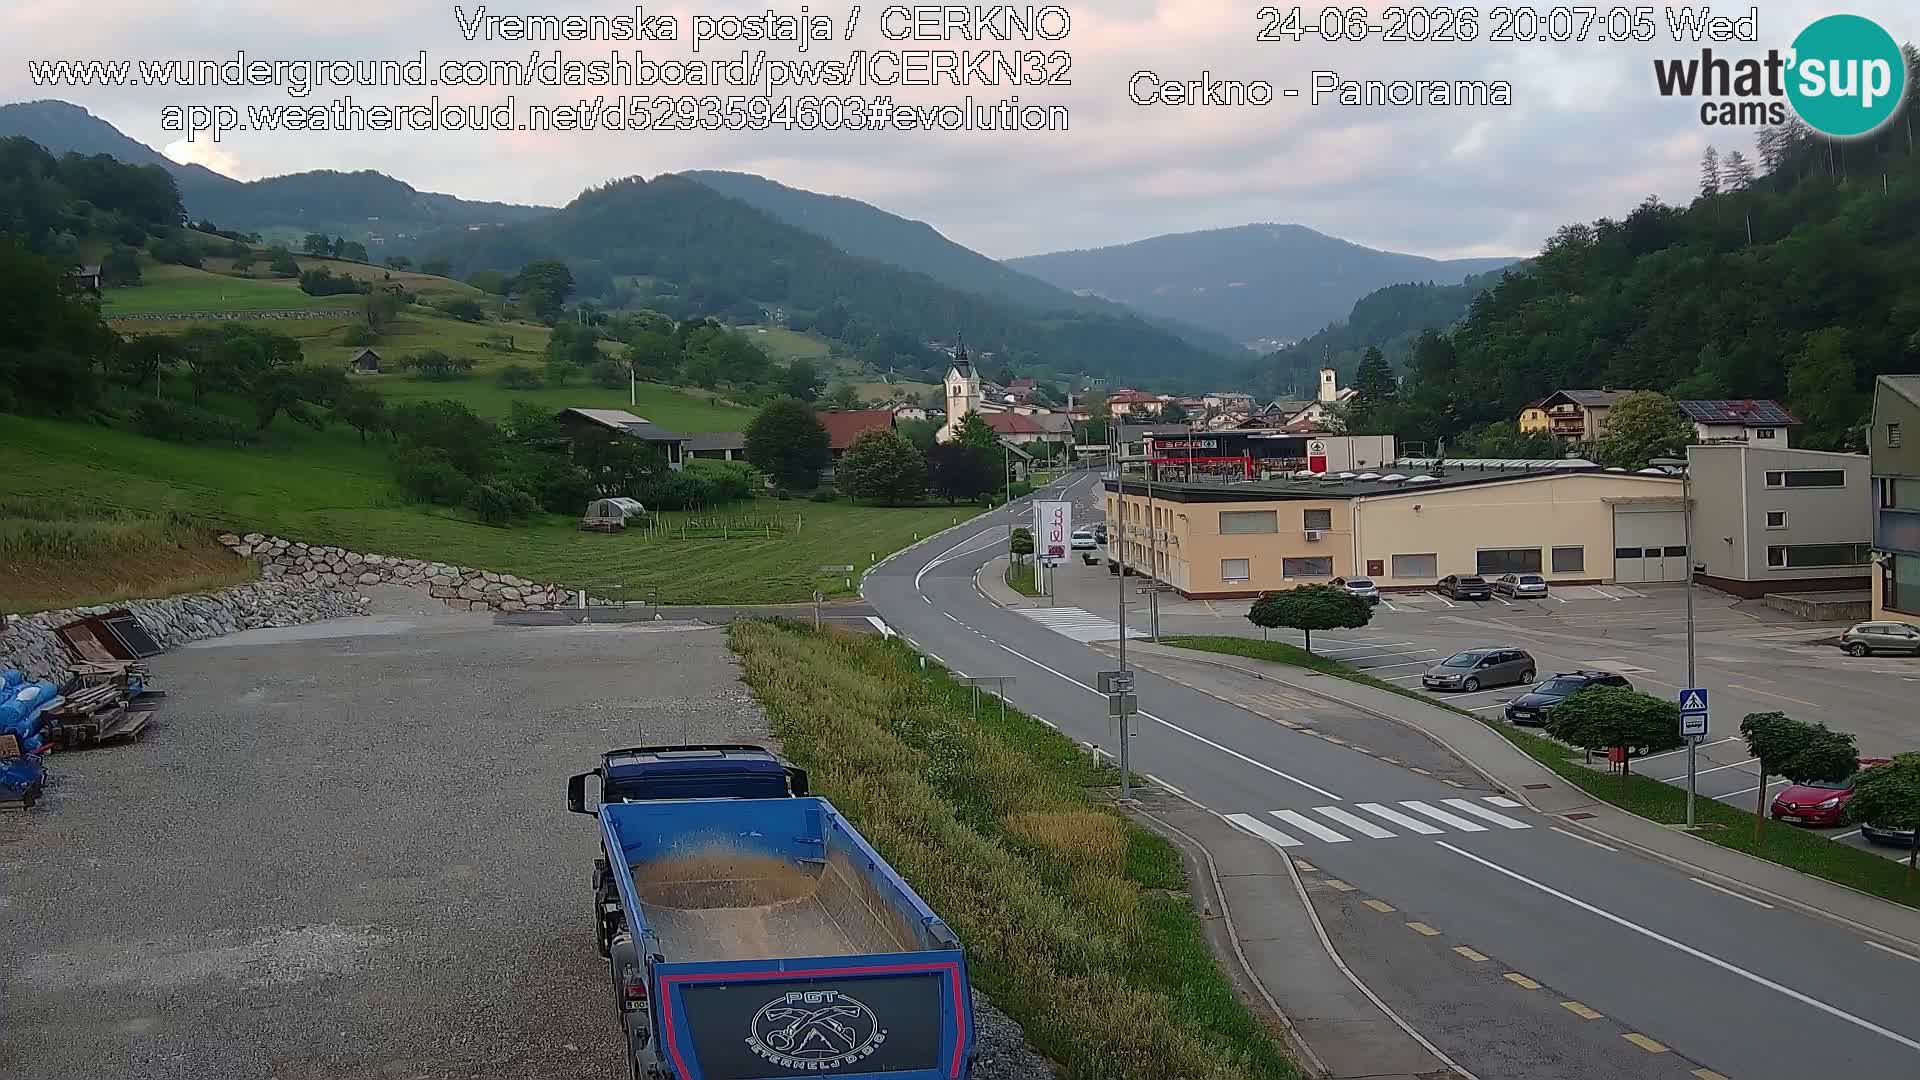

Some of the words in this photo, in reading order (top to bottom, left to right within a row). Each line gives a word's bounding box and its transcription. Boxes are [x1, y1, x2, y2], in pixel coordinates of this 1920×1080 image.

[1165, 441, 1202, 449] SPAR
[786, 991, 838, 1004] PGT
[744, 1036, 840, 1070] PETERNELJ
